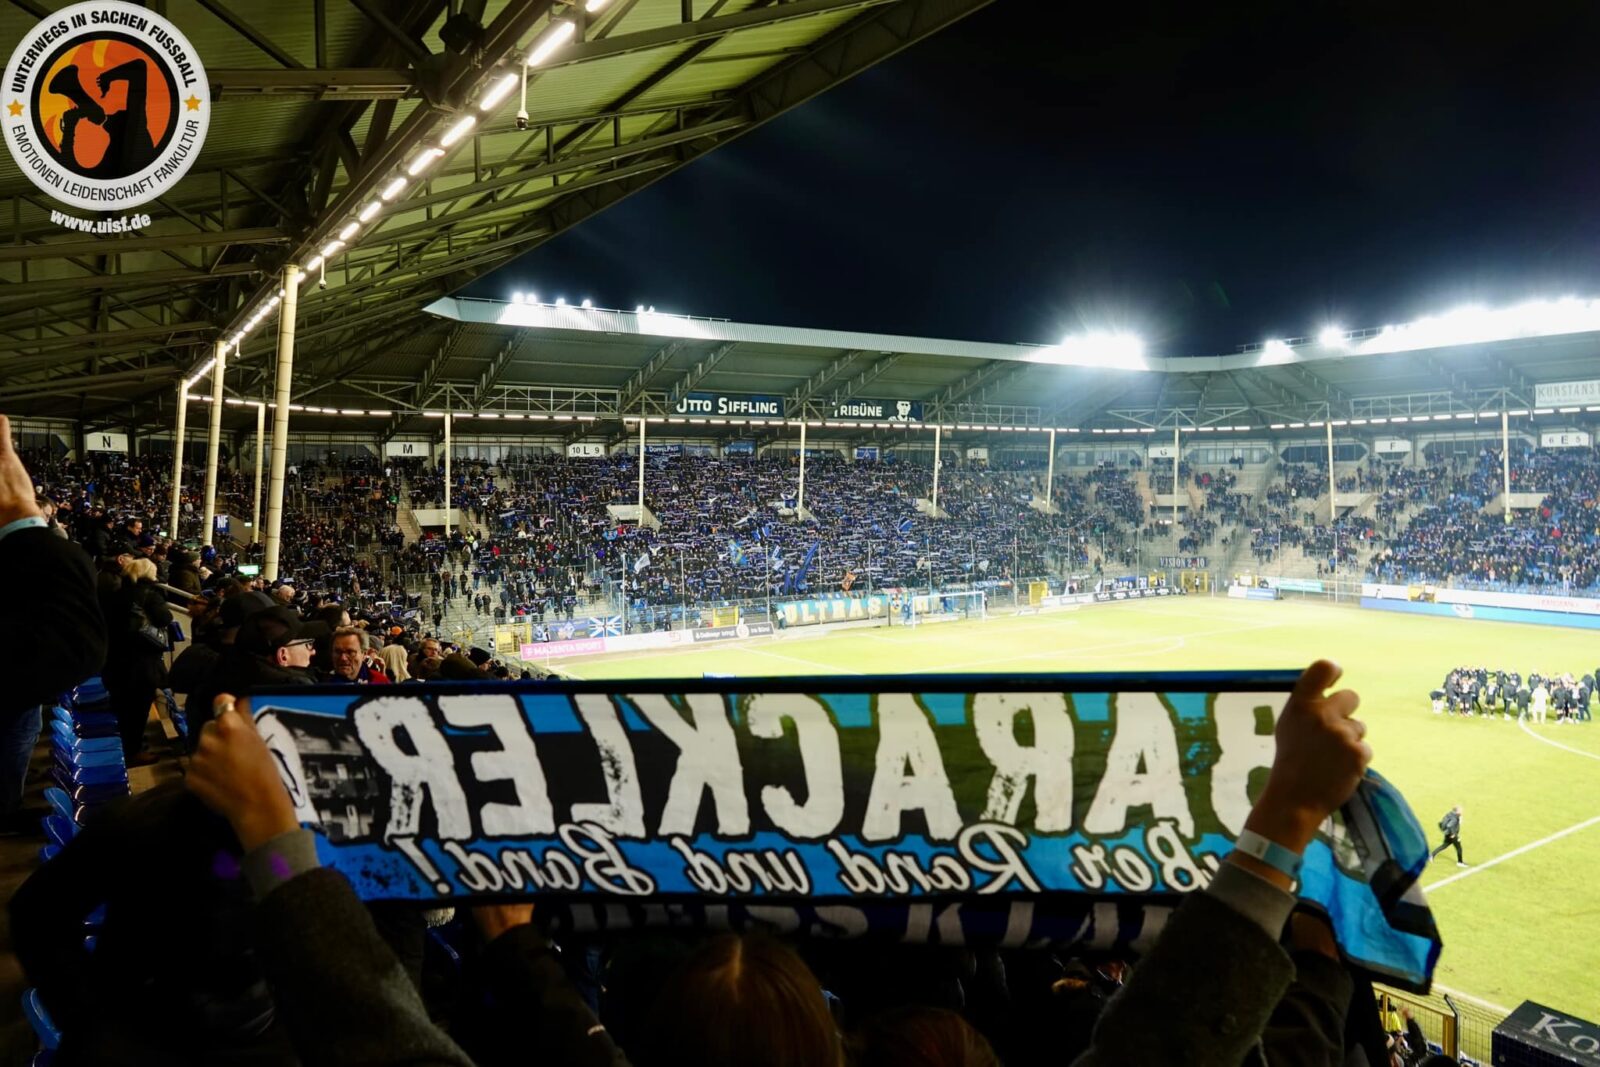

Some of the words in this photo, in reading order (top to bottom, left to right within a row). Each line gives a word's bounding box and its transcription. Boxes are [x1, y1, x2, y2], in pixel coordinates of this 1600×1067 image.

[718, 397, 778, 414] SIFFLING
[102, 435, 112, 449] N
[402, 443, 413, 455] M
[572, 446, 581, 454] 10
[583, 445, 590, 455] L
[594, 446, 600, 454] 9
[783, 597, 882, 625] ULTRAS
